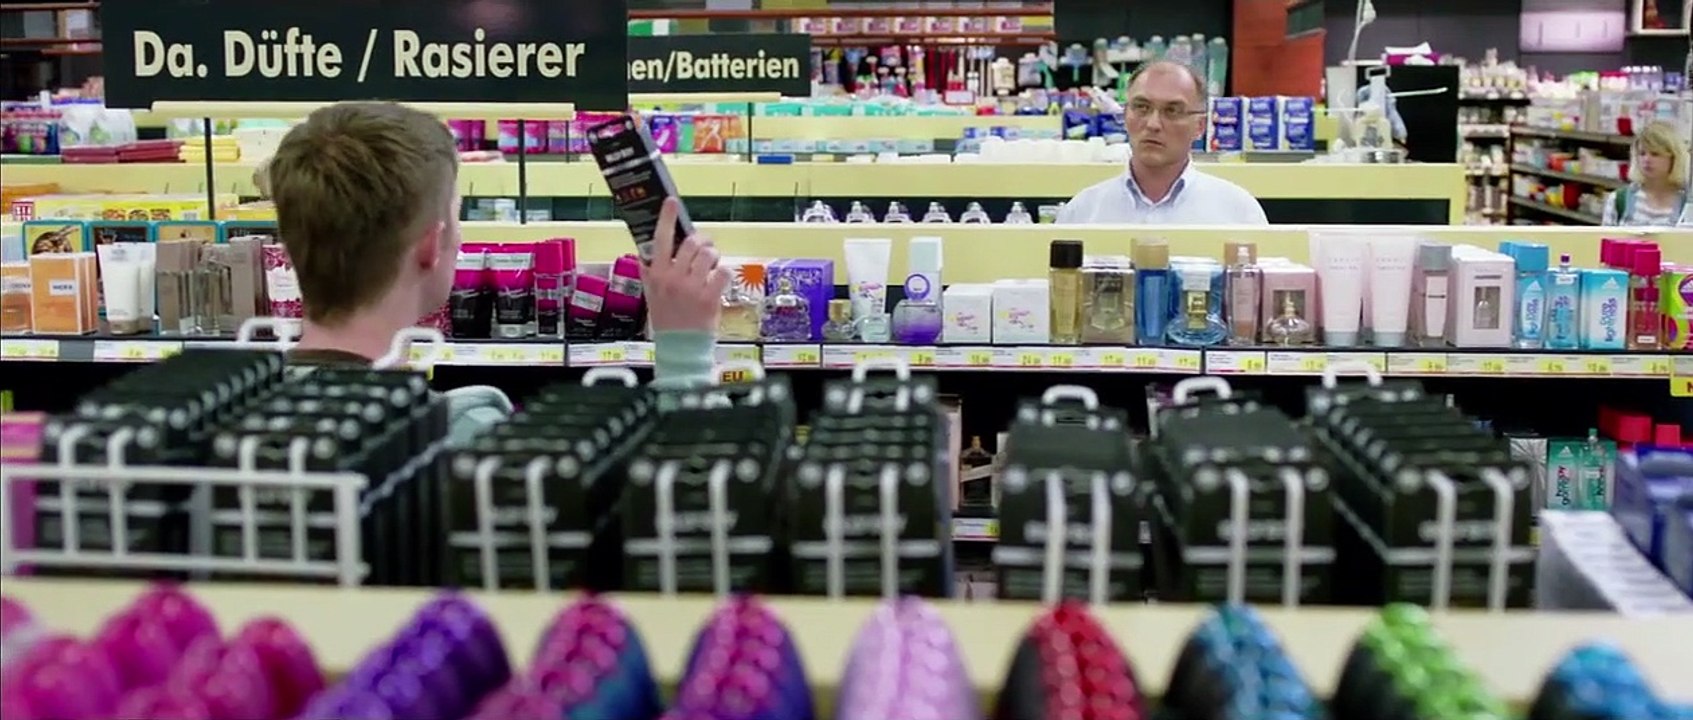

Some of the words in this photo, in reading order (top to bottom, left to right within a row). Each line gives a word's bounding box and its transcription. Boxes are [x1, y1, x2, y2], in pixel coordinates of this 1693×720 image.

[133, 30, 208, 78] Da.
[224, 27, 343, 78] Düfte
[357, 28, 379, 83] /
[394, 28, 586, 78] Rasierer
